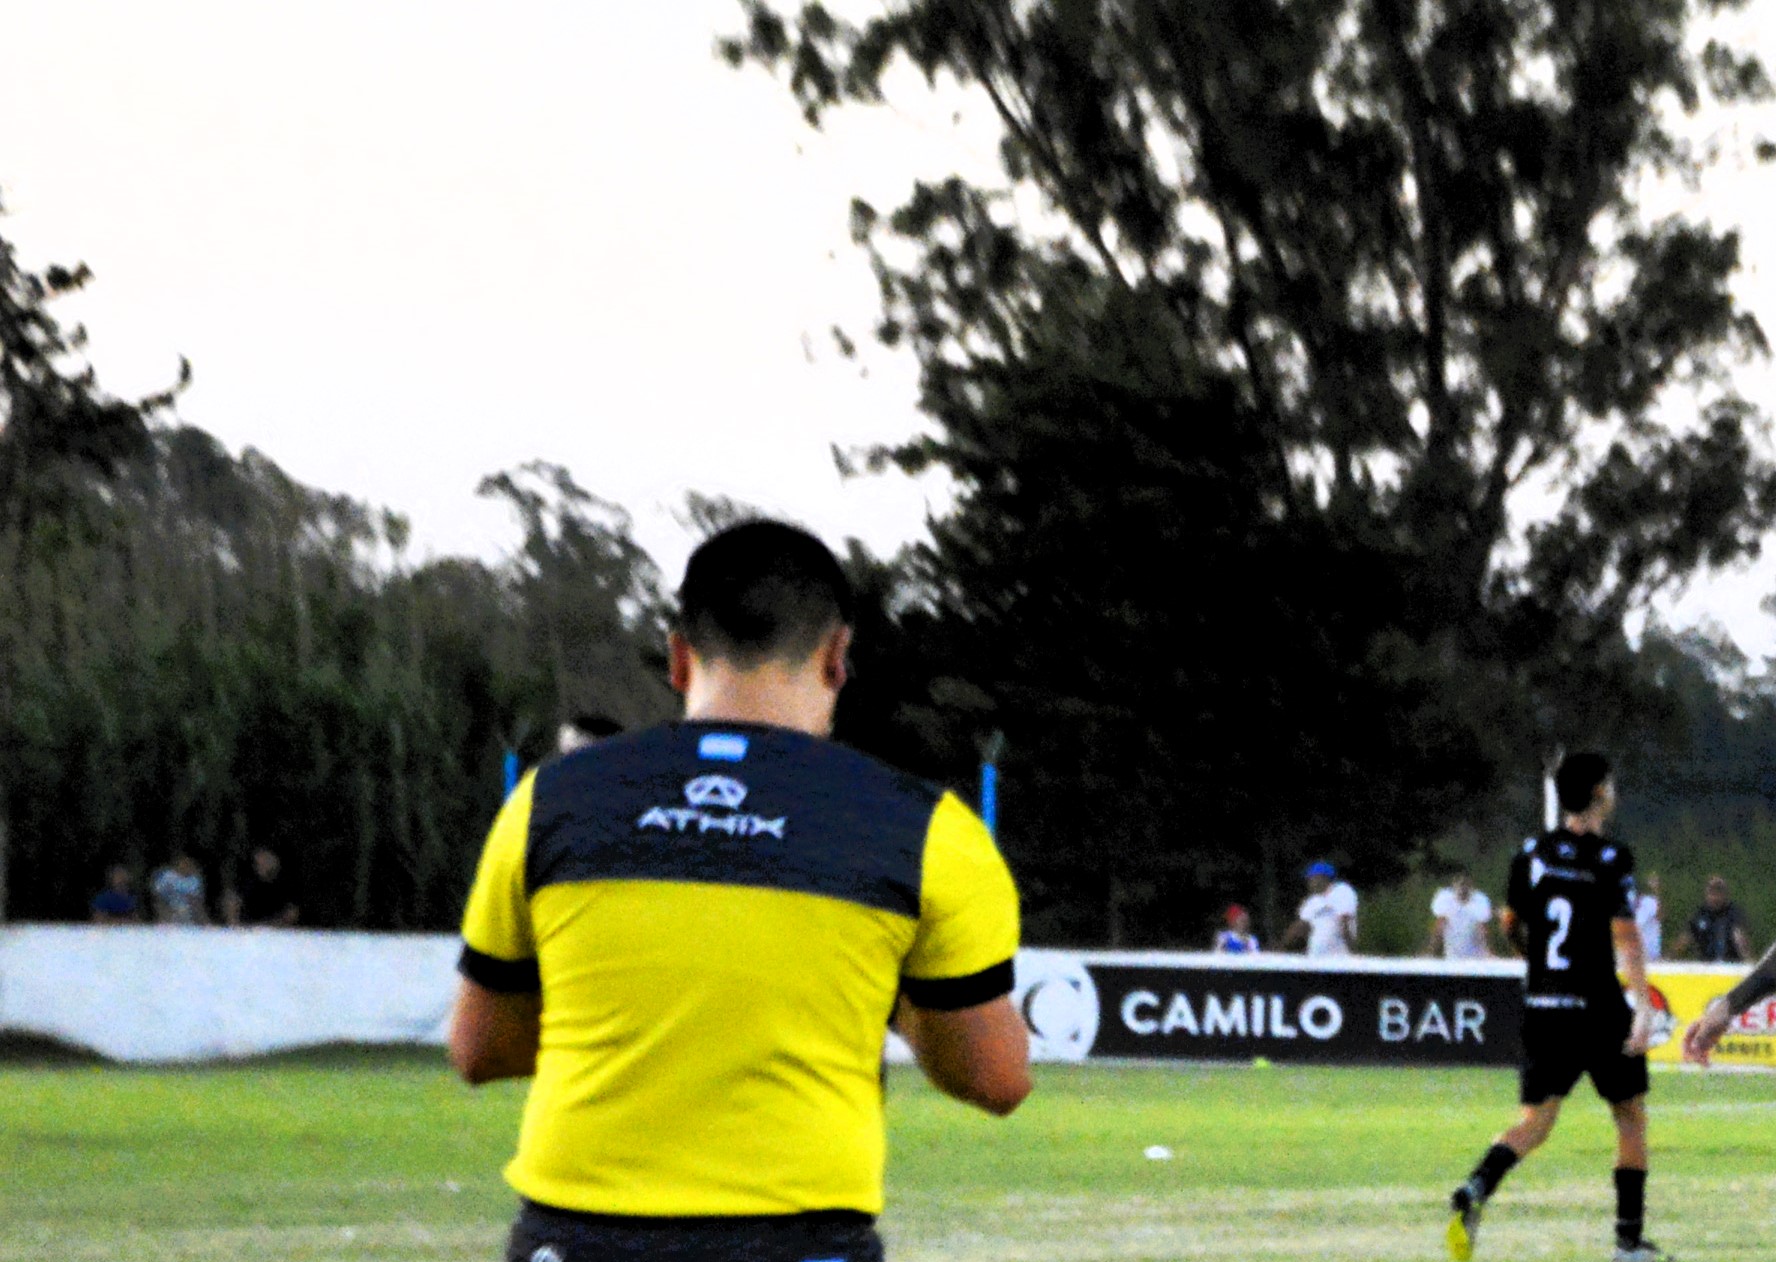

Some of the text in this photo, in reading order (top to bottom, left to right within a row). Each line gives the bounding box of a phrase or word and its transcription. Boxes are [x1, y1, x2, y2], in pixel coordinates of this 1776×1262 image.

[636, 806, 788, 839] ATHIX
[1545, 897, 1573, 970] 2
[1120, 989, 1486, 1045] CAMILO BAR
